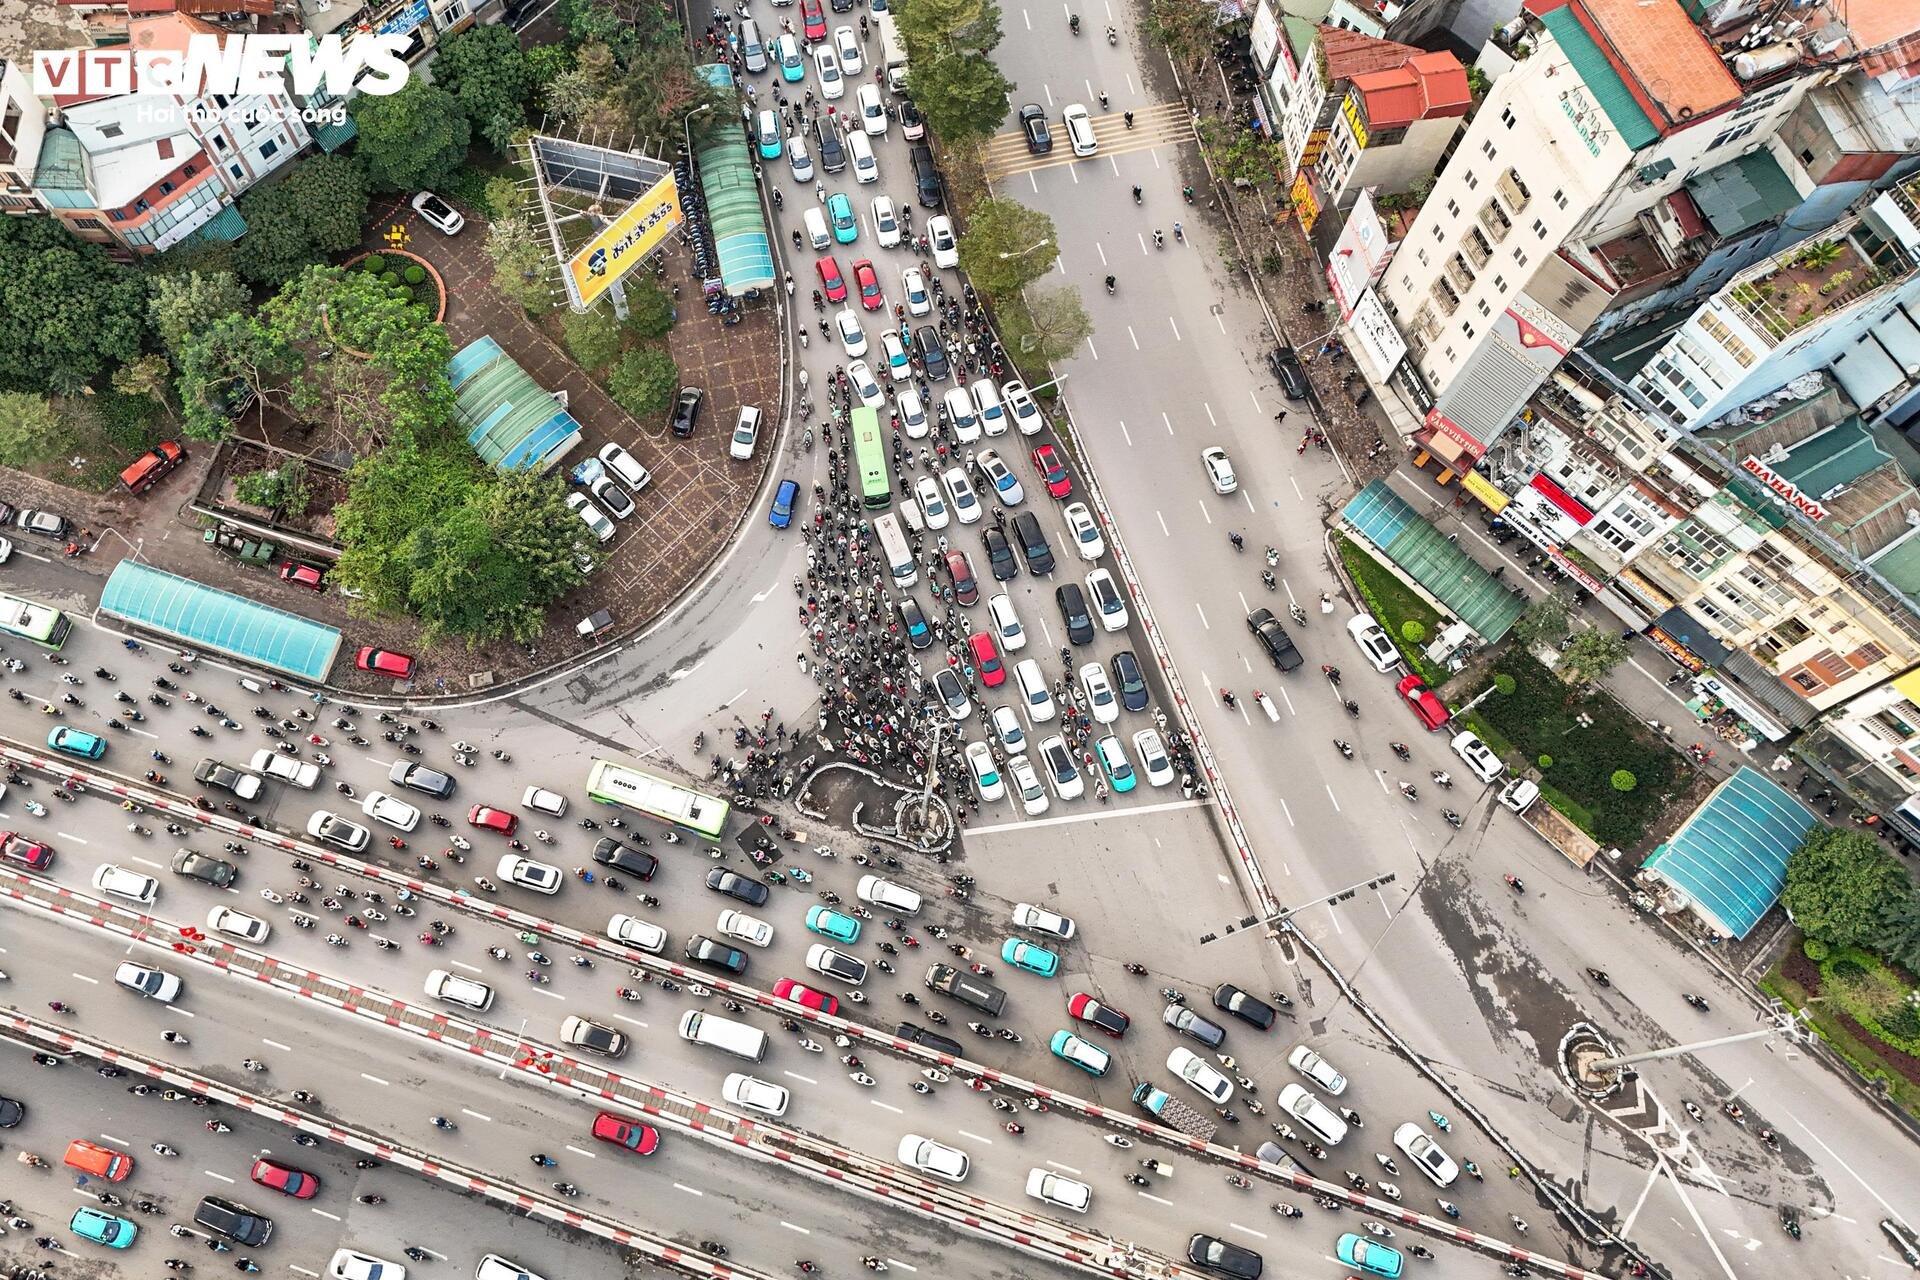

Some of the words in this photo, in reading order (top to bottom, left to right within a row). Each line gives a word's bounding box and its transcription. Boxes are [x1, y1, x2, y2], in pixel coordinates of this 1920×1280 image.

[1744, 459, 1770, 481] BIA
[1770, 478, 1794, 500] HÀ
[1793, 496, 1825, 520] NỘI
[1503, 510, 1533, 535] BILLIARDS
